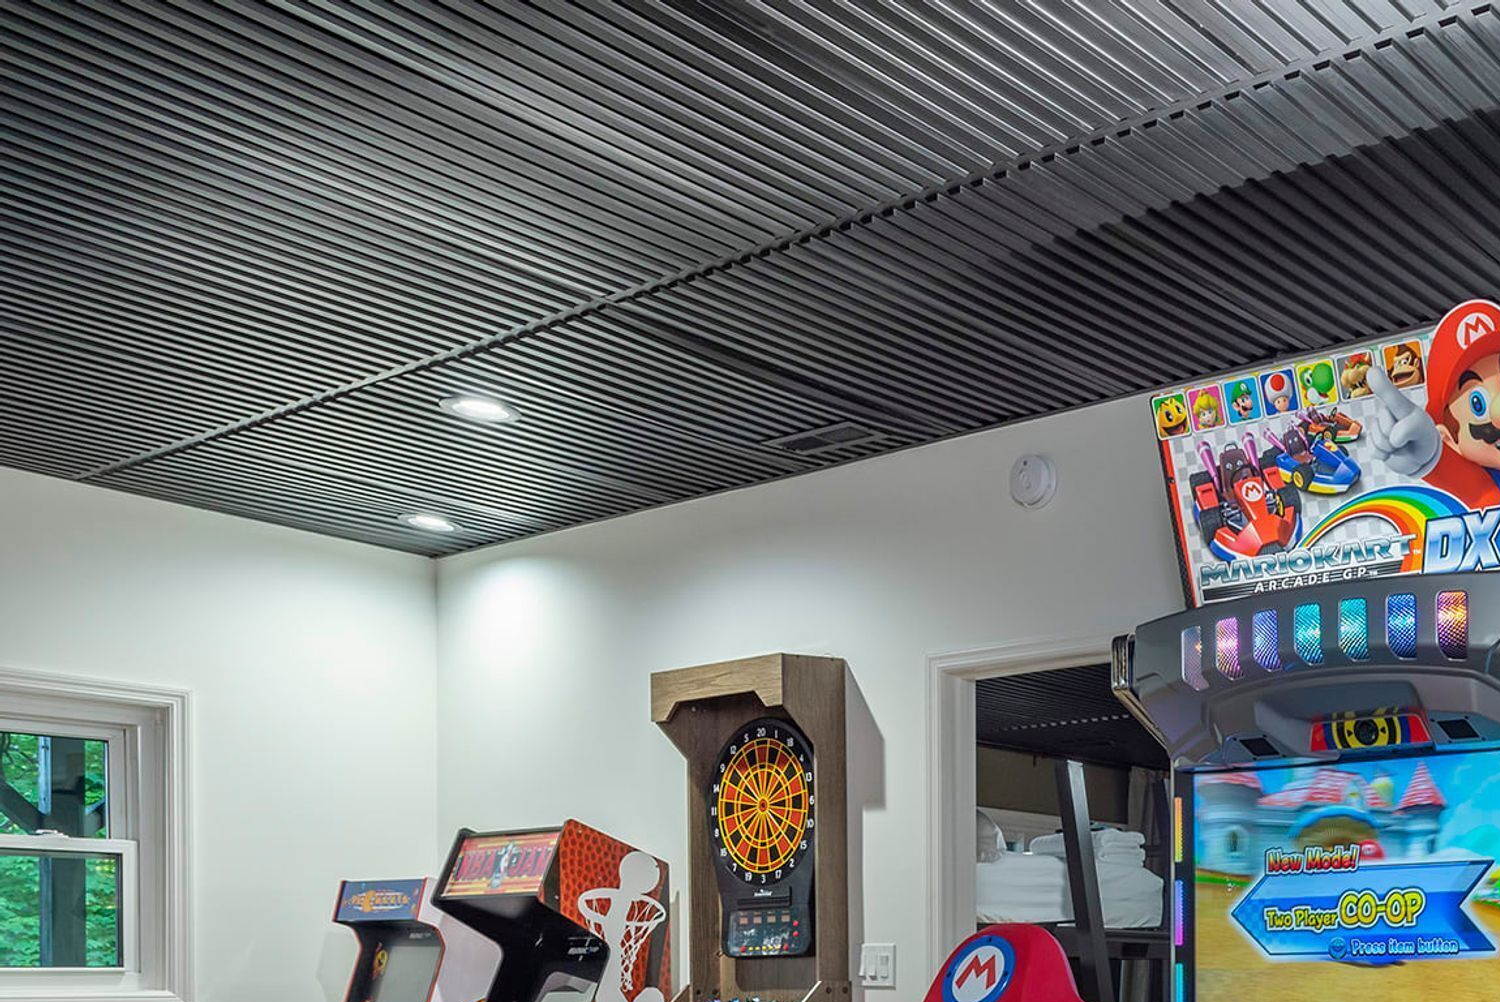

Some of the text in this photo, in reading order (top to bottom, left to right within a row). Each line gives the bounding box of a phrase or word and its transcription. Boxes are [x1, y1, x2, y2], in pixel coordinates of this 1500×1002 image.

[1253, 567, 1367, 594] ARCADE GP
[757, 728, 766, 737] 20
[789, 858, 795, 868] 2
[1267, 846, 1357, 873] New Mode!
[761, 874, 766, 884] 3
[1265, 891, 1424, 931] Two Player CO-OP
[1352, 937, 1458, 955] Press item button
